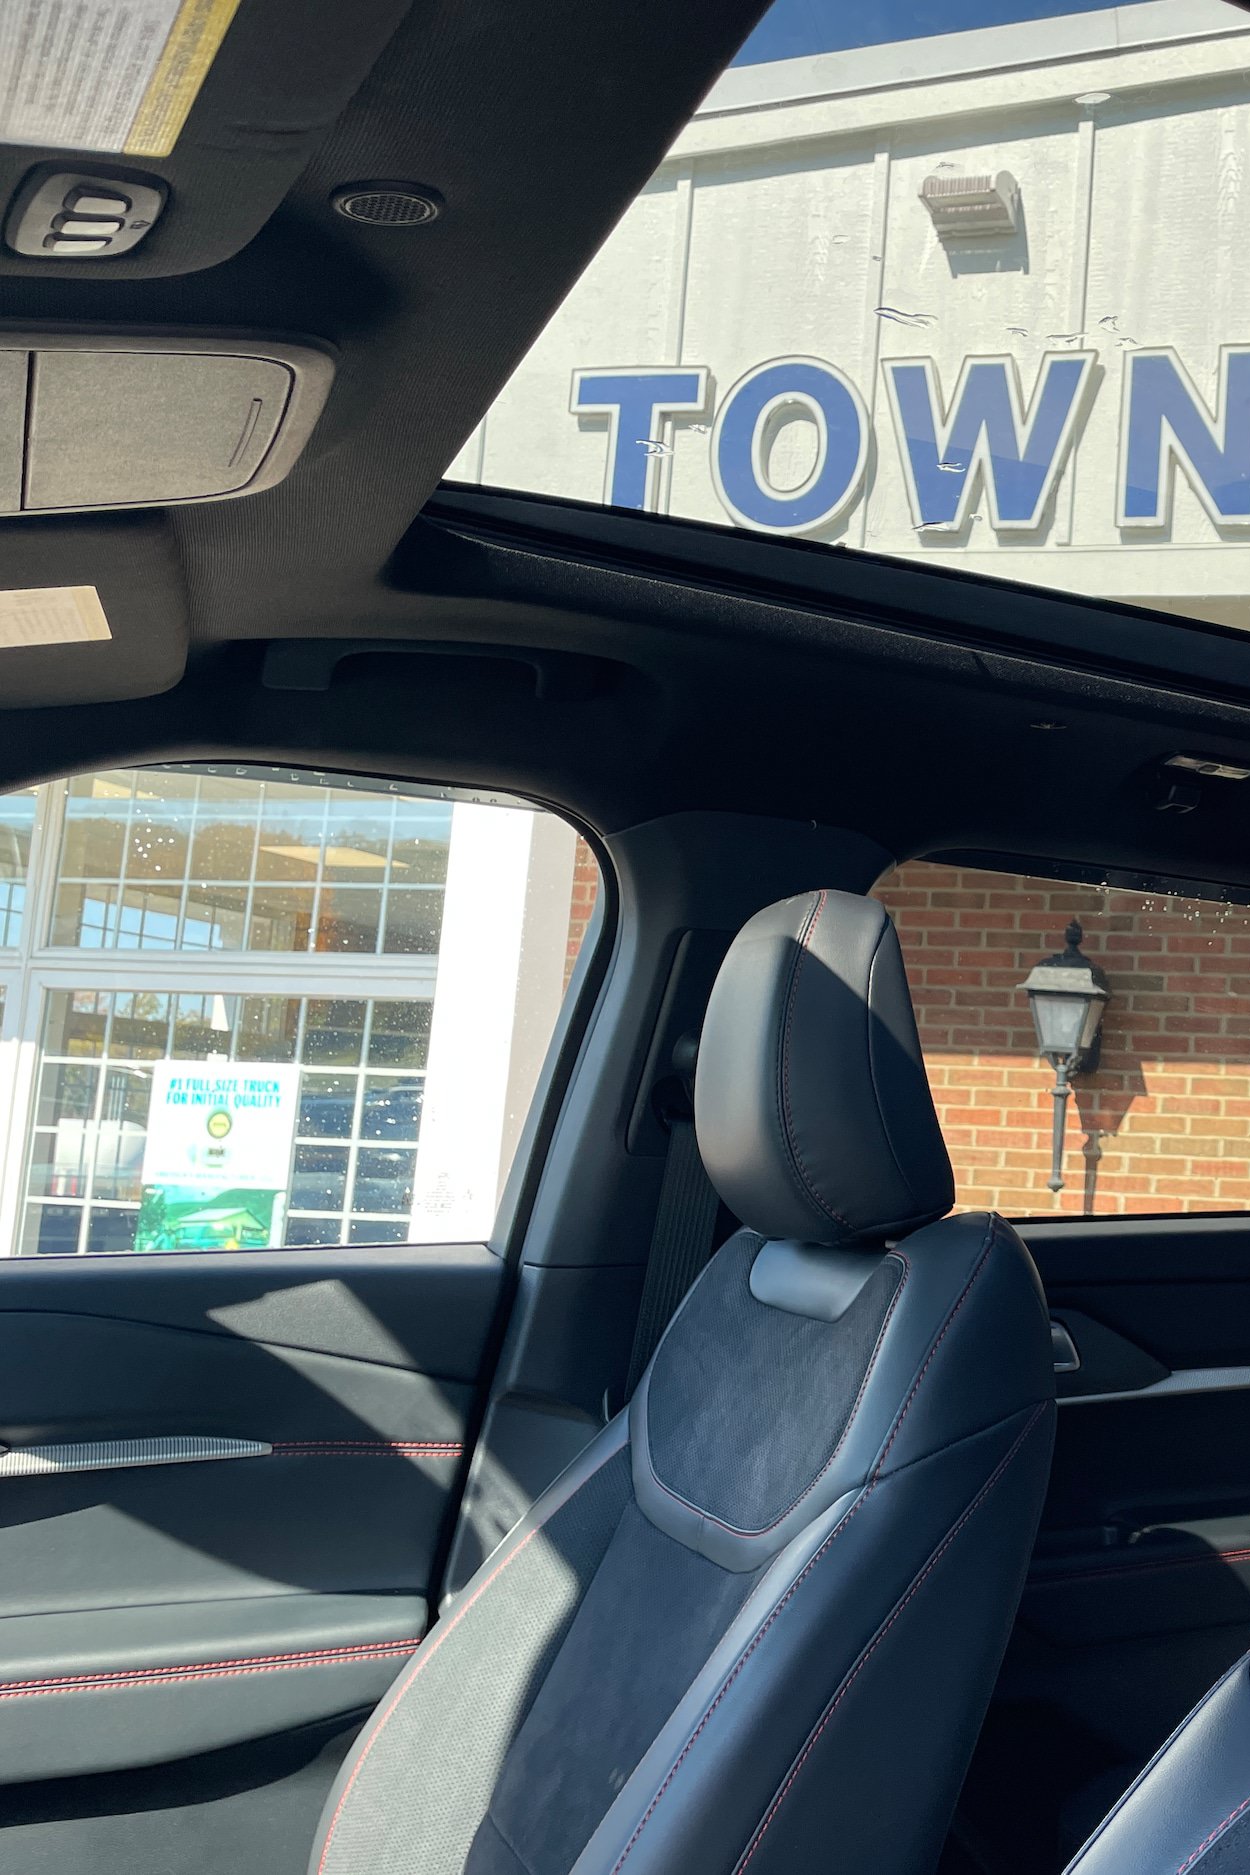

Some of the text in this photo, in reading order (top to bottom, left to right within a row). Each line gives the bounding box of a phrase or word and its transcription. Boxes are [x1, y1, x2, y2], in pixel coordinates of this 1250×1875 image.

[170, 1078, 280, 1092] #1 FULL SIZE TRUCK
[166, 1091, 282, 1109] FOR INITIAL QUALITY
